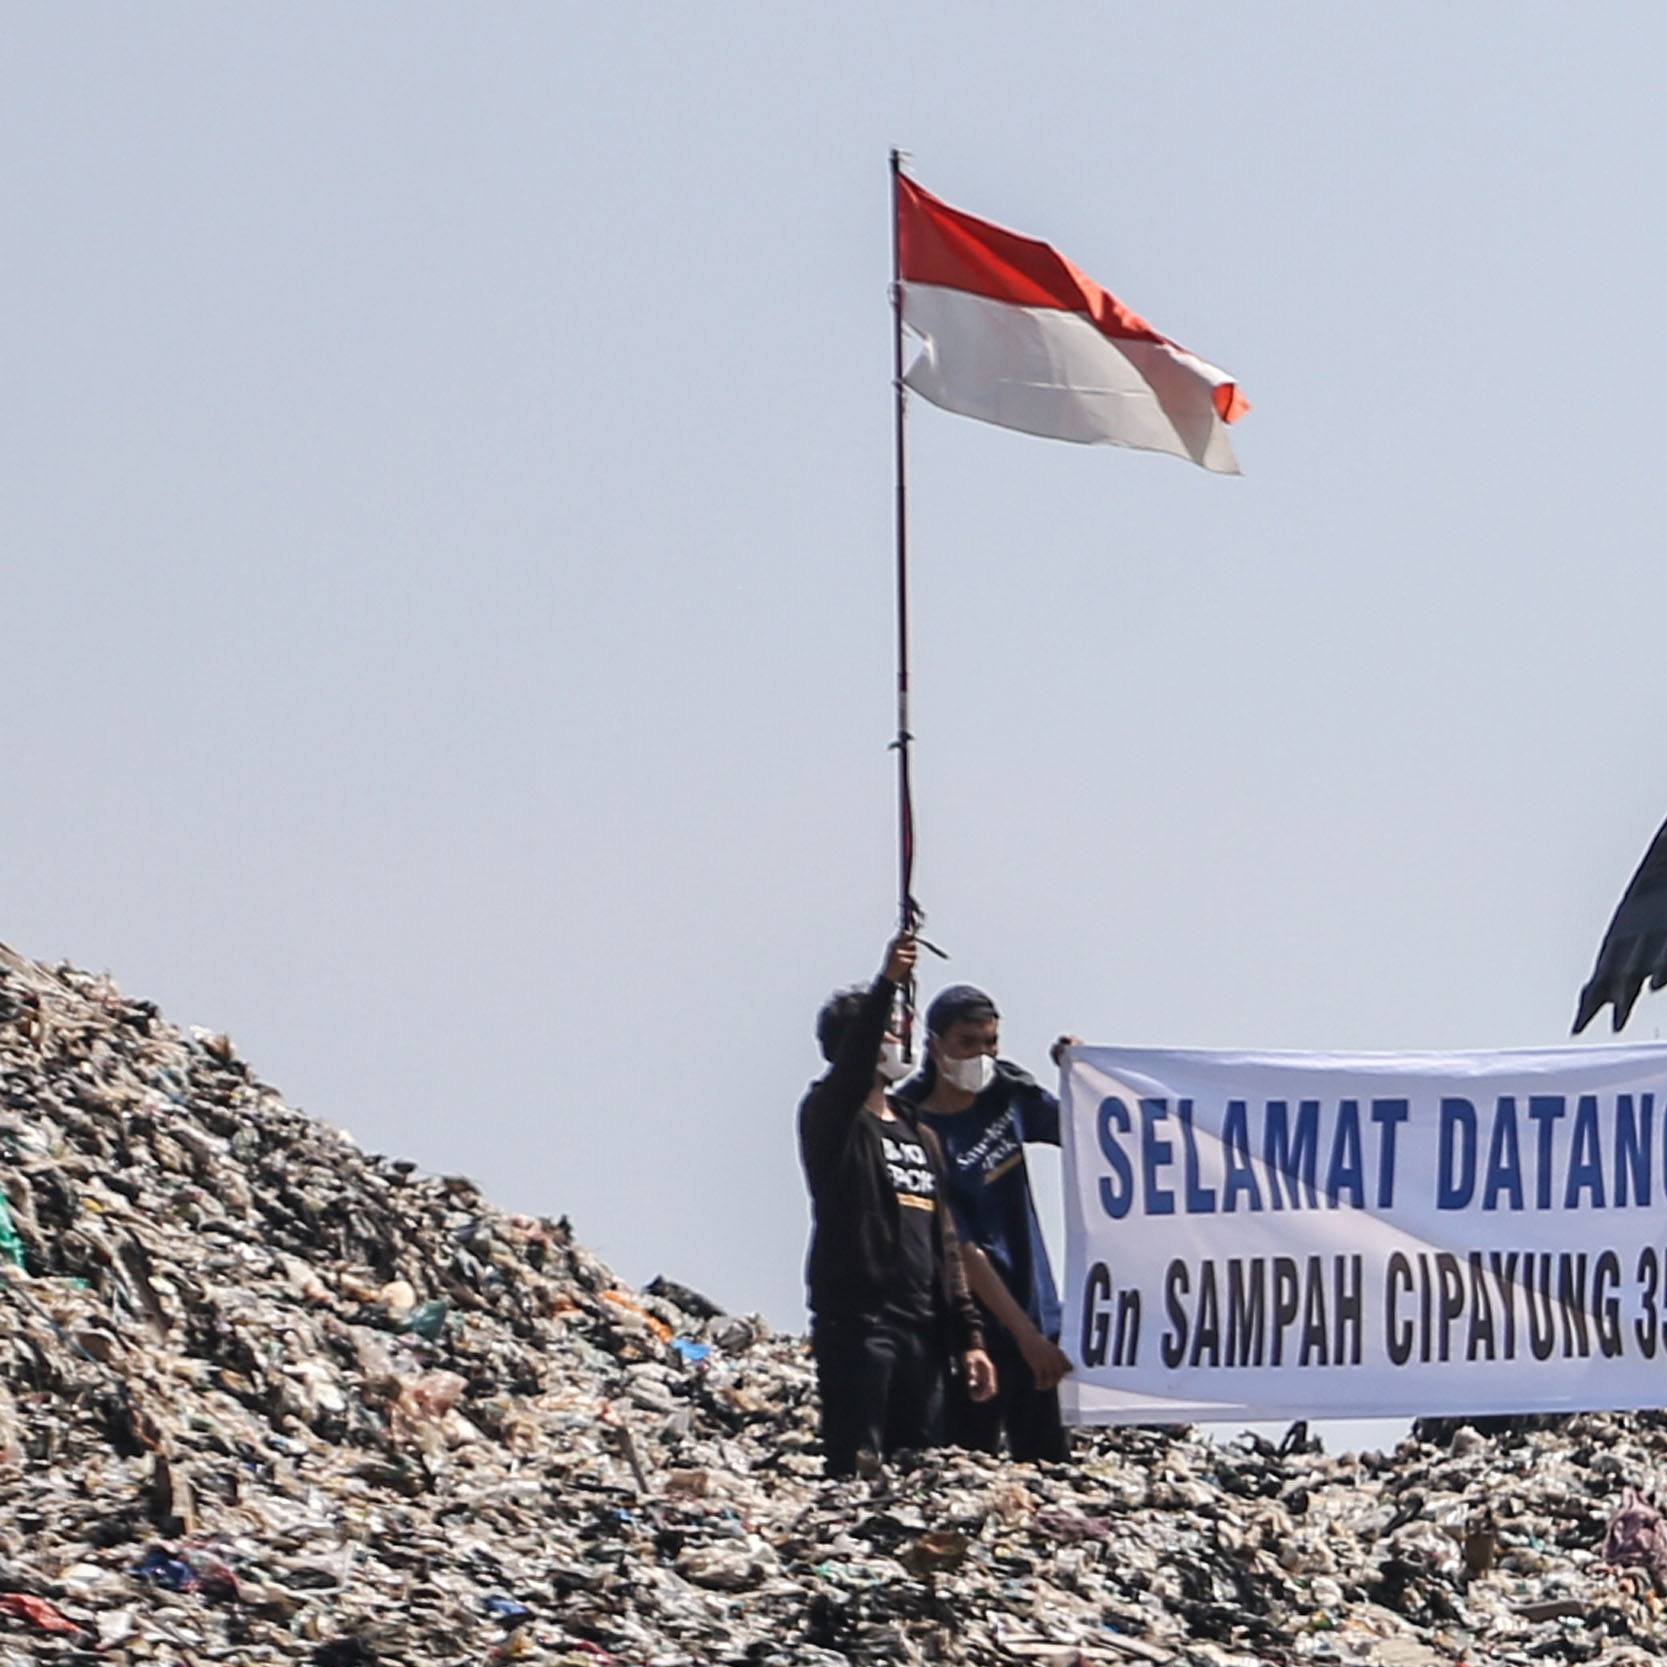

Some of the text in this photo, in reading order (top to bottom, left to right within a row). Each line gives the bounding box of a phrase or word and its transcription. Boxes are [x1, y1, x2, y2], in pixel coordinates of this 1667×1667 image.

[1096, 1096, 1409, 1220] SELAMAT
[1079, 1261, 1141, 1368] Gn
[1160, 1253, 1363, 1369] SAMPAH
[1385, 1249, 1624, 1366] CIPAYUNG
